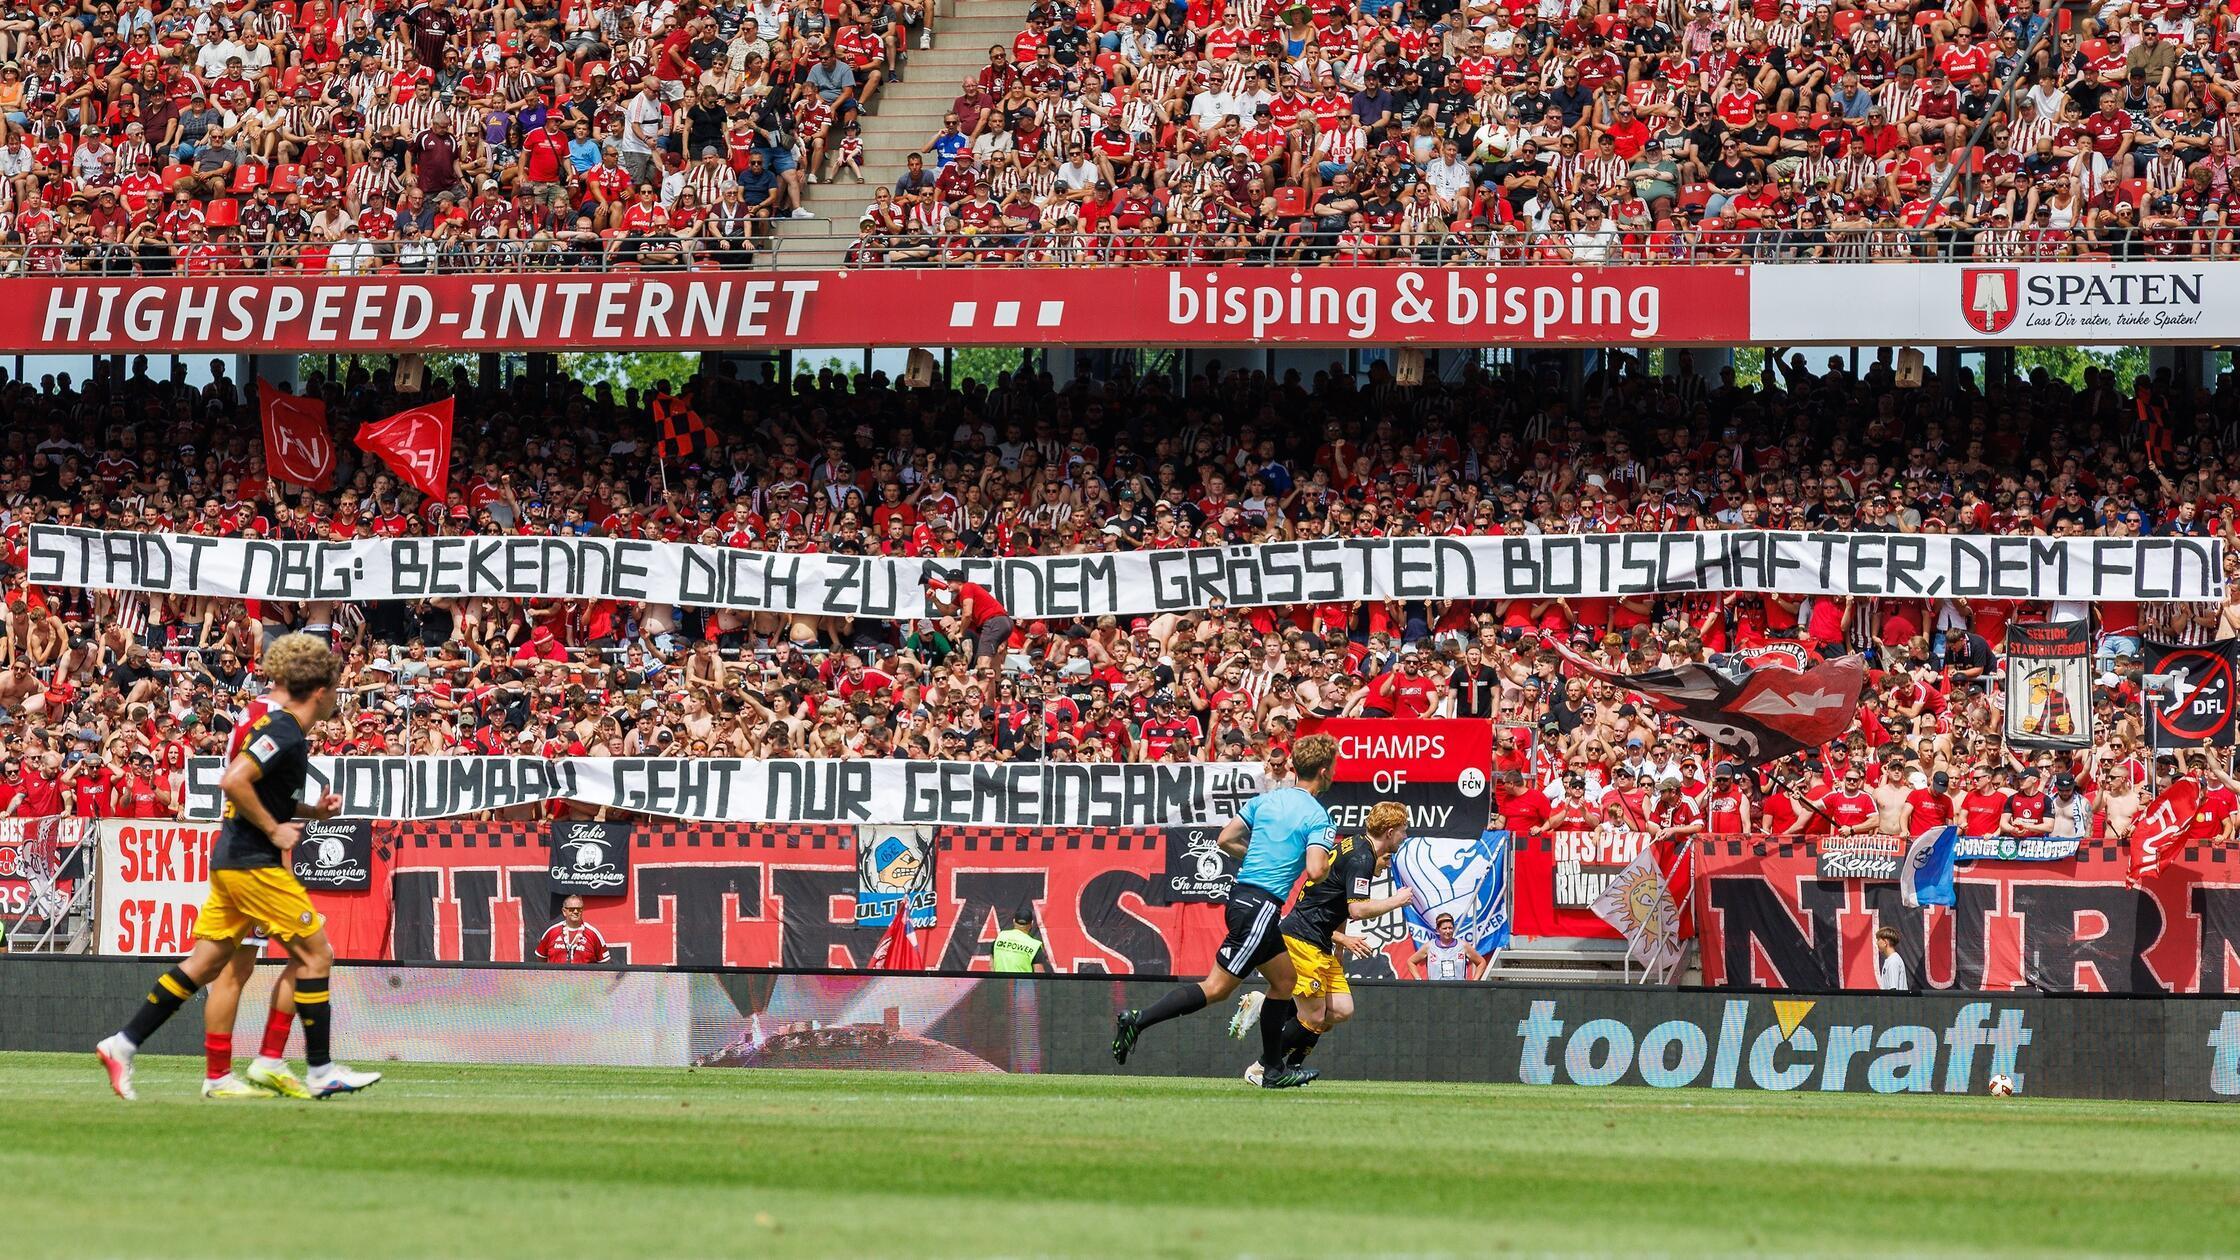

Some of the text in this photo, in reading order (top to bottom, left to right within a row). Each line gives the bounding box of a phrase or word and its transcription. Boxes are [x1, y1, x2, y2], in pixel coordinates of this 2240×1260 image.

[2027, 274, 2204, 307] SPATEN
[42, 279, 820, 342] HIGHSPEED-INTERNET
[1168, 271, 1660, 339] bisping & bisping
[2026, 310, 2202, 329] Lass Dir raten, trinke Spaten!
[30, 526, 218, 591] STADT
[240, 541, 364, 598] NBG:
[392, 538, 652, 600] BEKENNE
[679, 545, 800, 609] DICH
[823, 555, 896, 617] ZU
[1150, 538, 1476, 607] GRÖSSTEN
[2093, 538, 2224, 599] FCN!
[2027, 627, 2068, 640] SEKTION
[2193, 699, 2226, 716] DFL
[1338, 735, 1445, 760] CHAMPS
[1373, 770, 1407, 794] OF
[1462, 779, 1482, 790] FCN
[612, 758, 742, 820] GEHT
[766, 761, 872, 822] NUR
[904, 762, 1207, 827] GEMEINSAM!
[1329, 804, 1454, 828] GERANY
[306, 820, 357, 836] Susanne
[568, 823, 606, 839] Fabio
[1822, 836, 1900, 852] DURCHHALTEN
[1557, 860, 1581, 876] UND
[1823, 851, 1897, 872] Kevin
[314, 866, 367, 878] memoriam
[571, 870, 624, 882] memoriam
[1007, 942, 1034, 955] POWER
[1517, 1000, 2033, 1094] toolcraft
